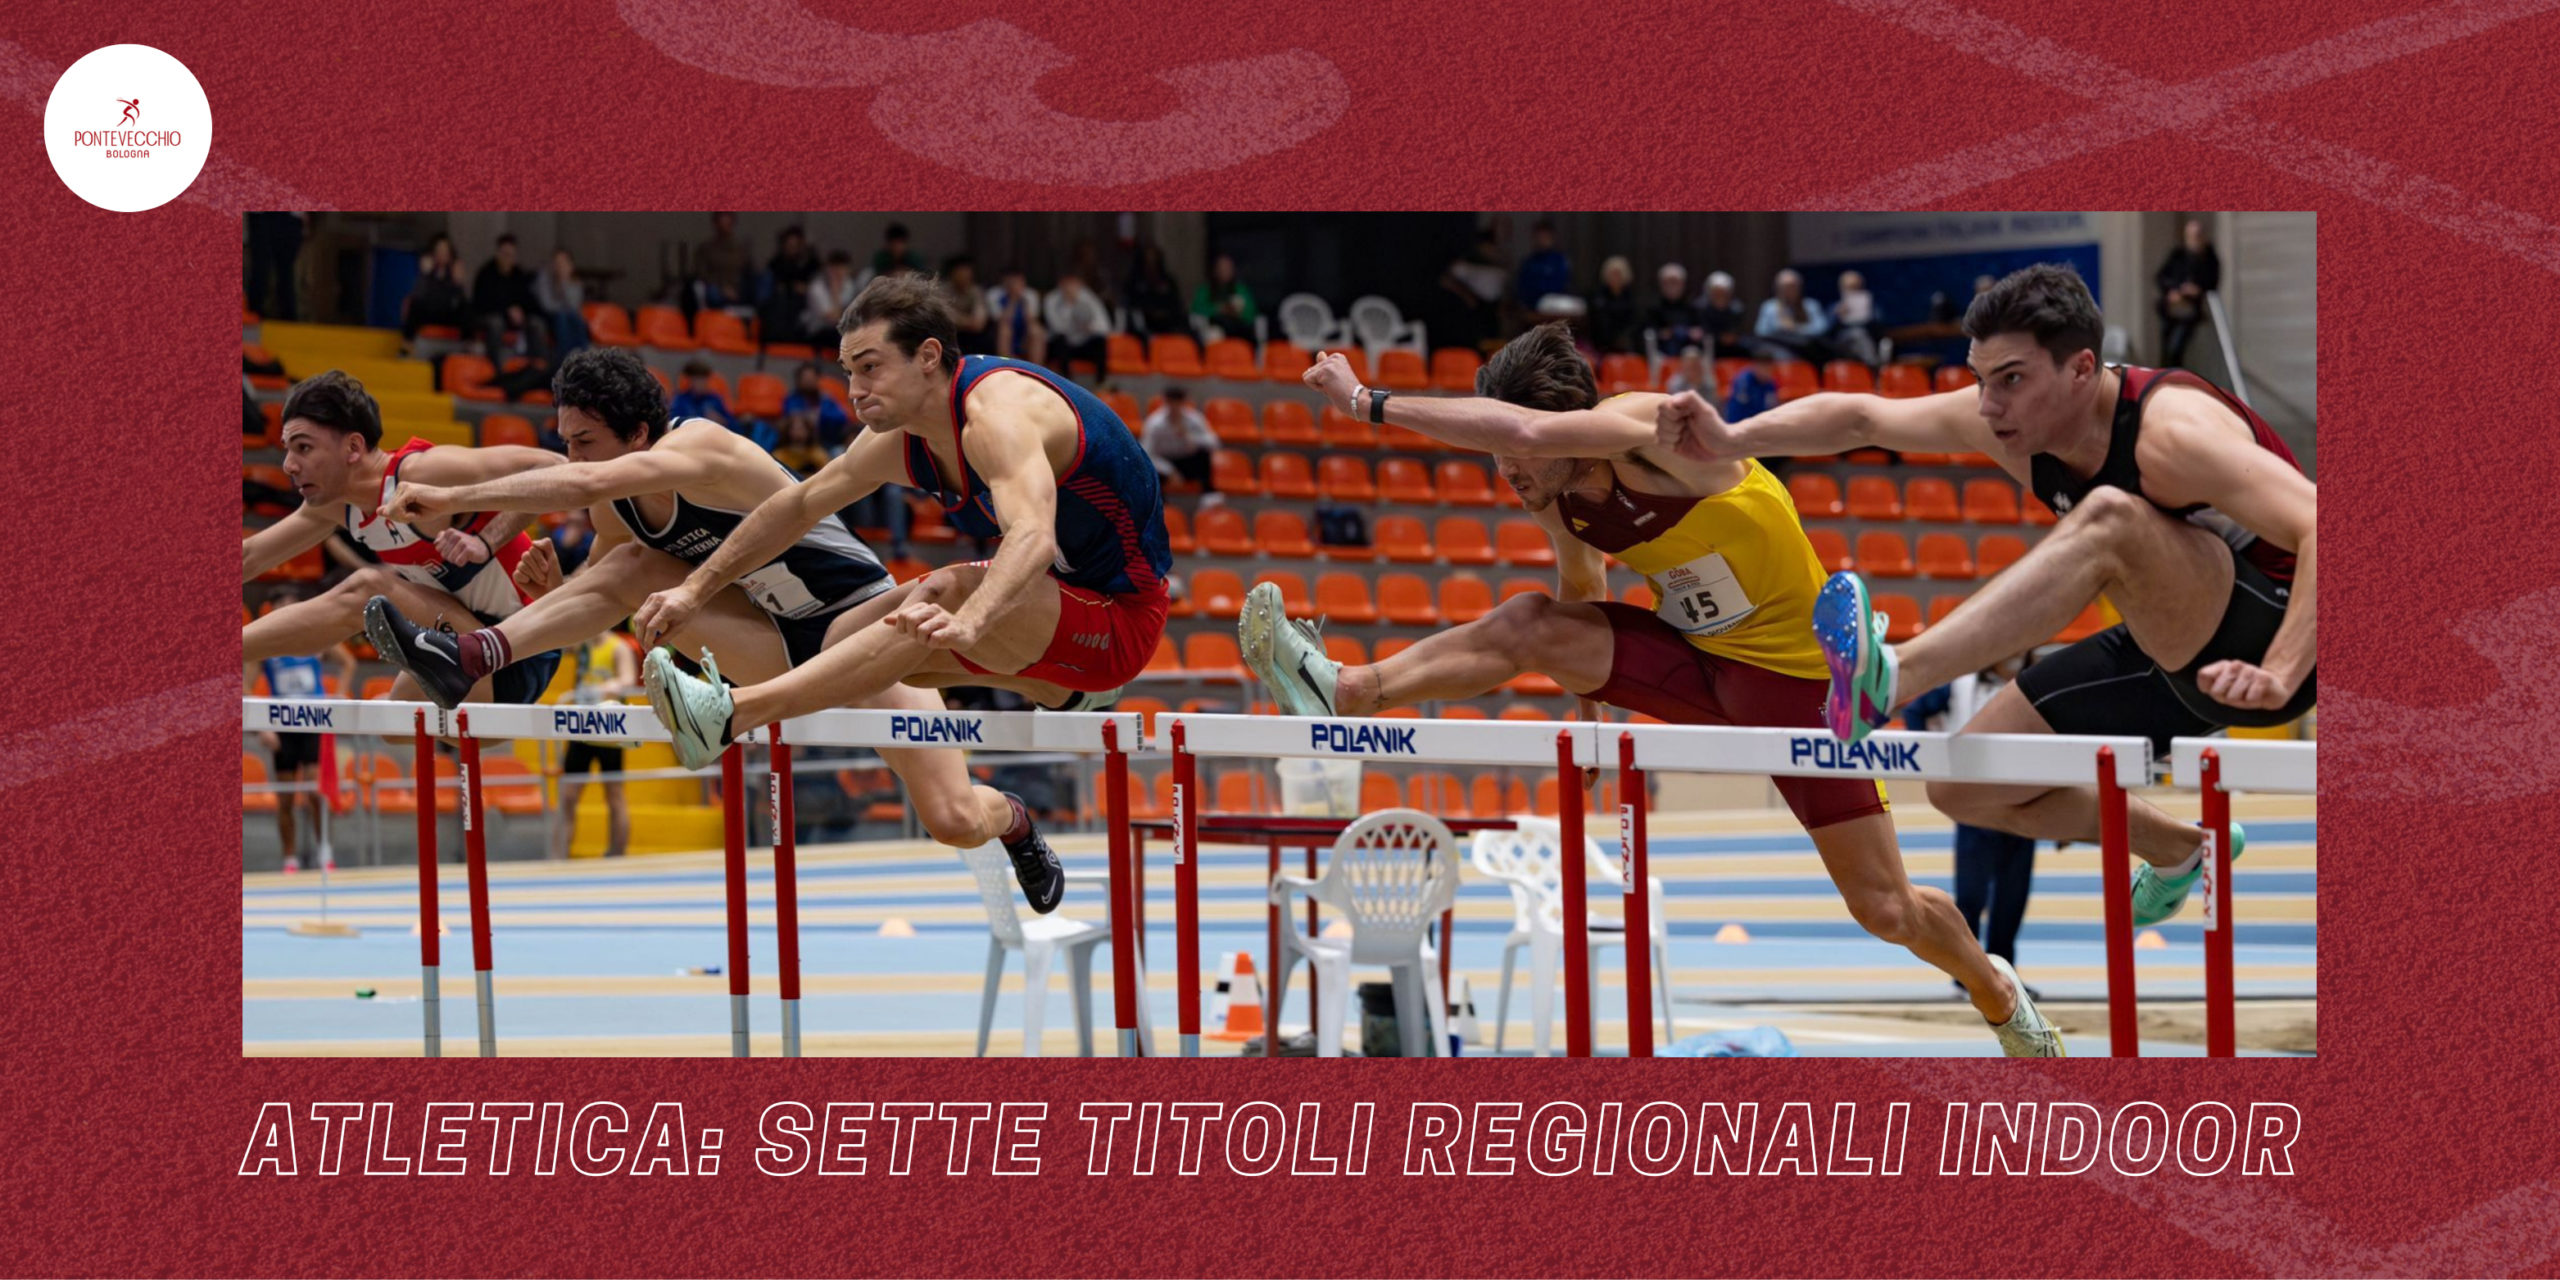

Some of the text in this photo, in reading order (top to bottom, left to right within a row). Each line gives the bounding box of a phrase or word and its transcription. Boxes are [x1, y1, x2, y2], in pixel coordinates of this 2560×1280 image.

[766, 592, 784, 612] 1
[1680, 591, 1719, 624] 45
[269, 704, 332, 727] POLANIK
[555, 710, 627, 736] POLANIK
[891, 716, 983, 743] POLANIK
[1312, 723, 1416, 755] POLANIK
[1790, 737, 1921, 772] POLANIK
